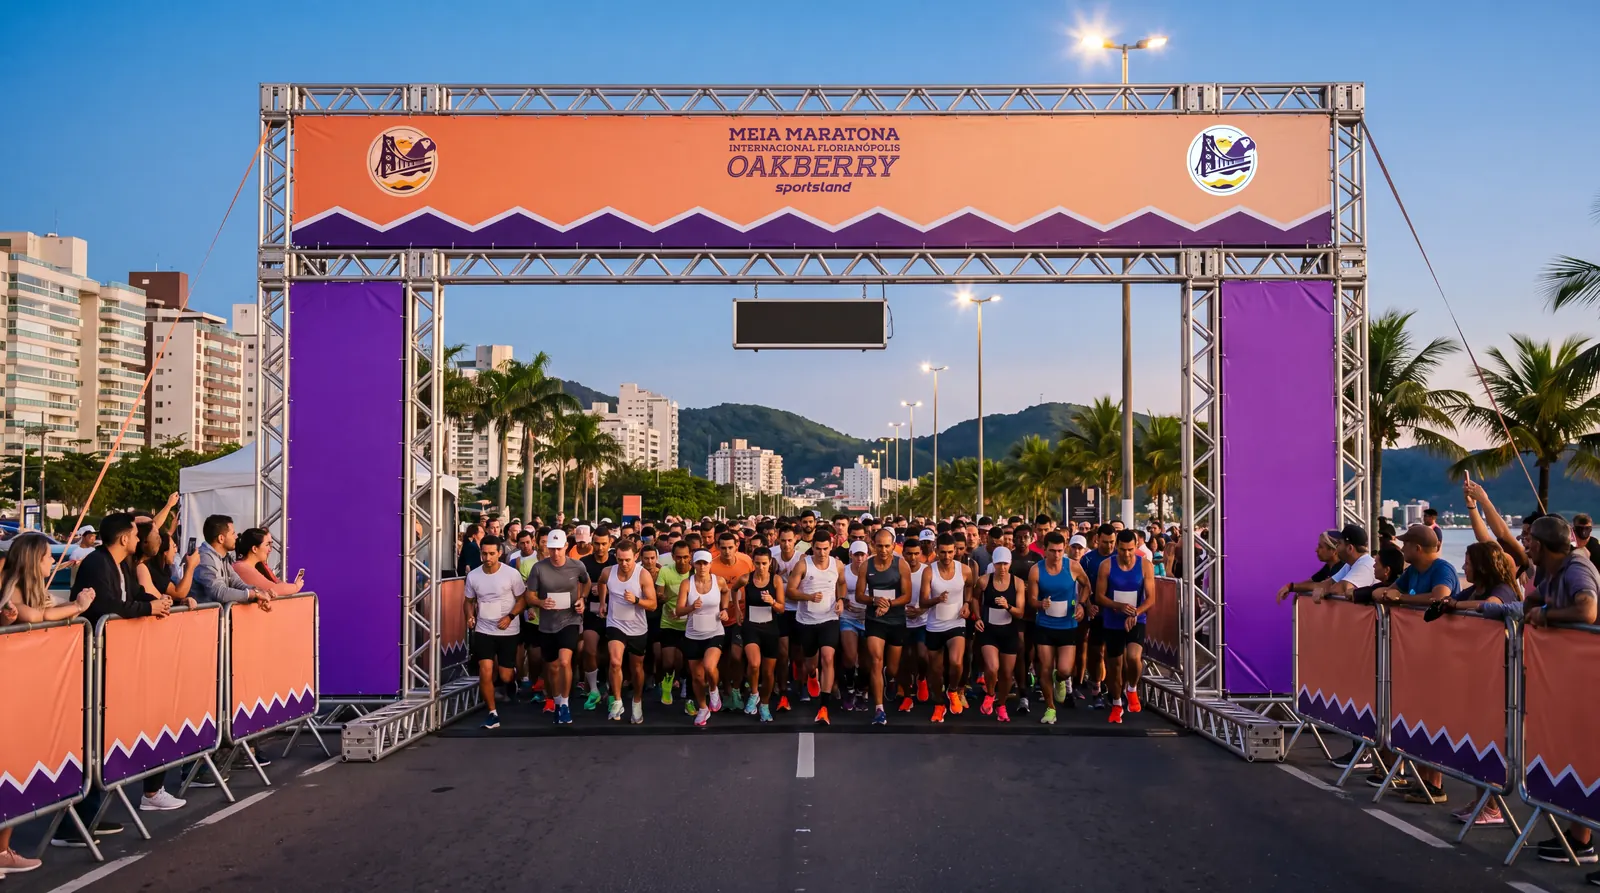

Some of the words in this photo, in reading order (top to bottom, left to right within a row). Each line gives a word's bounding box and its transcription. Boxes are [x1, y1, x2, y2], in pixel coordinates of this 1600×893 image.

[729, 127, 781, 141] MEIA
[786, 127, 900, 141] MARATONA
[729, 144, 815, 152] INTERNACIONAL
[817, 142, 900, 152] FLORIANÓPOLIS
[727, 155, 900, 178] OAKBERRY
[775, 181, 852, 195] sportsland
